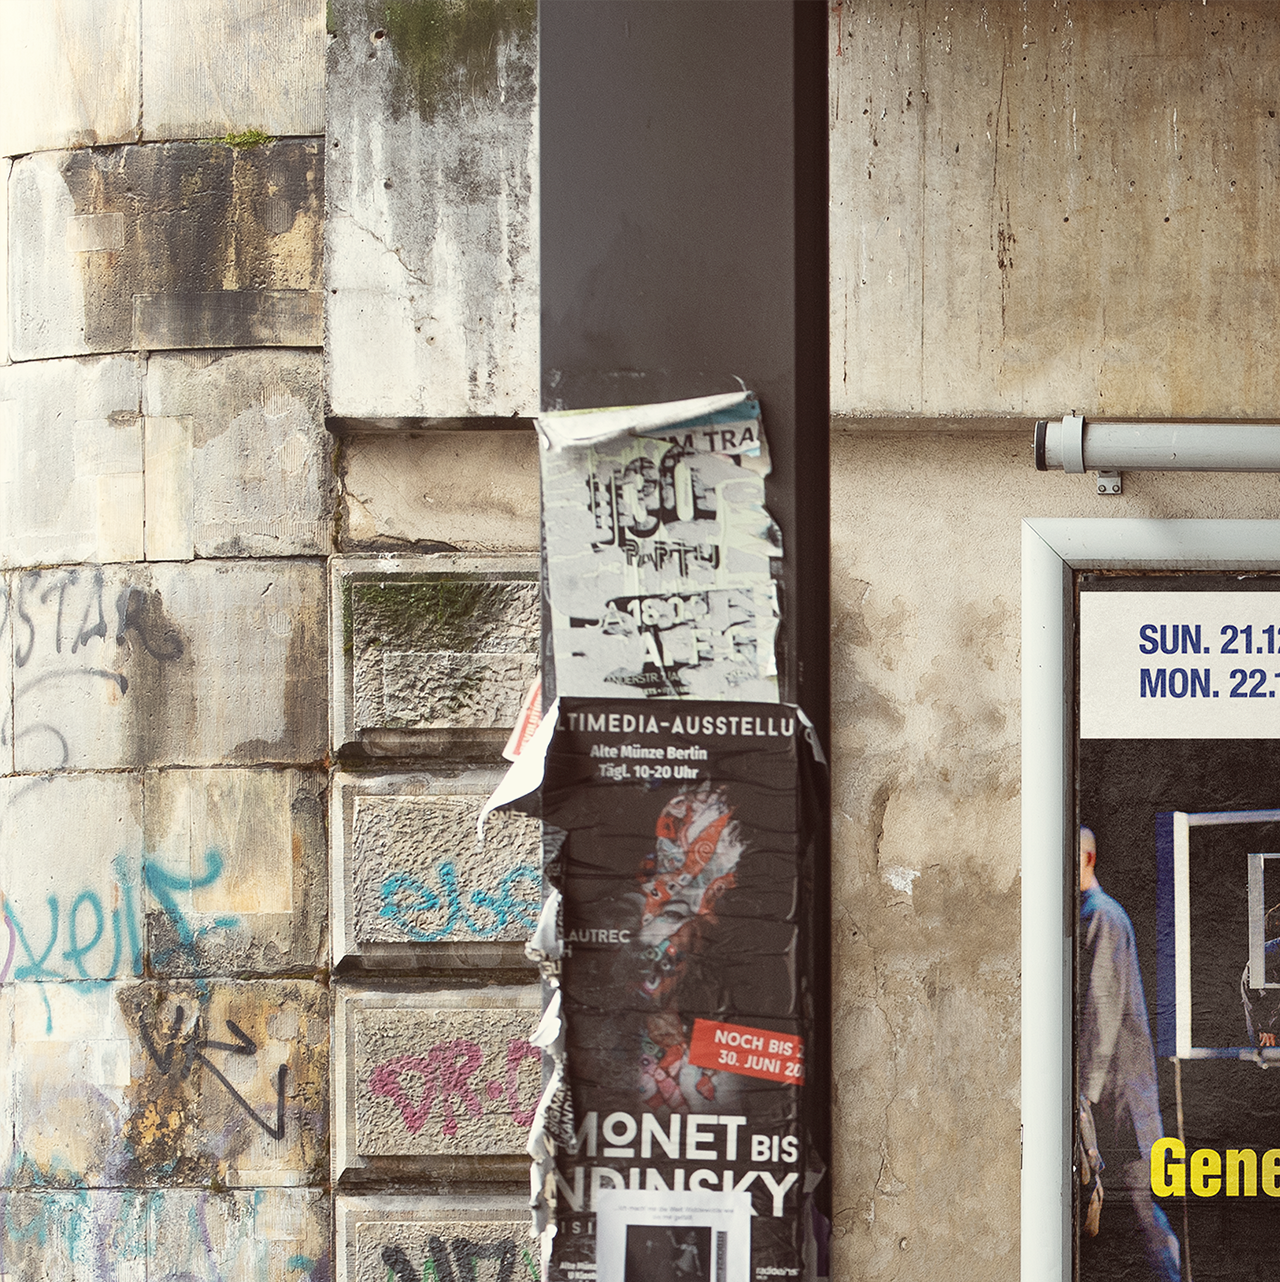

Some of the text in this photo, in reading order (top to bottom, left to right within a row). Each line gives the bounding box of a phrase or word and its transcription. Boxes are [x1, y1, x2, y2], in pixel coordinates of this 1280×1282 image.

[1139, 624, 1209, 654] SUN.
[1141, 668, 1219, 698] MON.
[590, 744, 708, 760] Alte Münze Berlin
[600, 764, 699, 780] Tägl. 10-20 Uhr
[715, 1030, 793, 1056] NOCH BIS
[718, 1050, 740, 1067] 30.
[744, 1055, 780, 1074] JUNI
[563, 1111, 747, 1161] MONET
[751, 1135, 799, 1163] BIS
